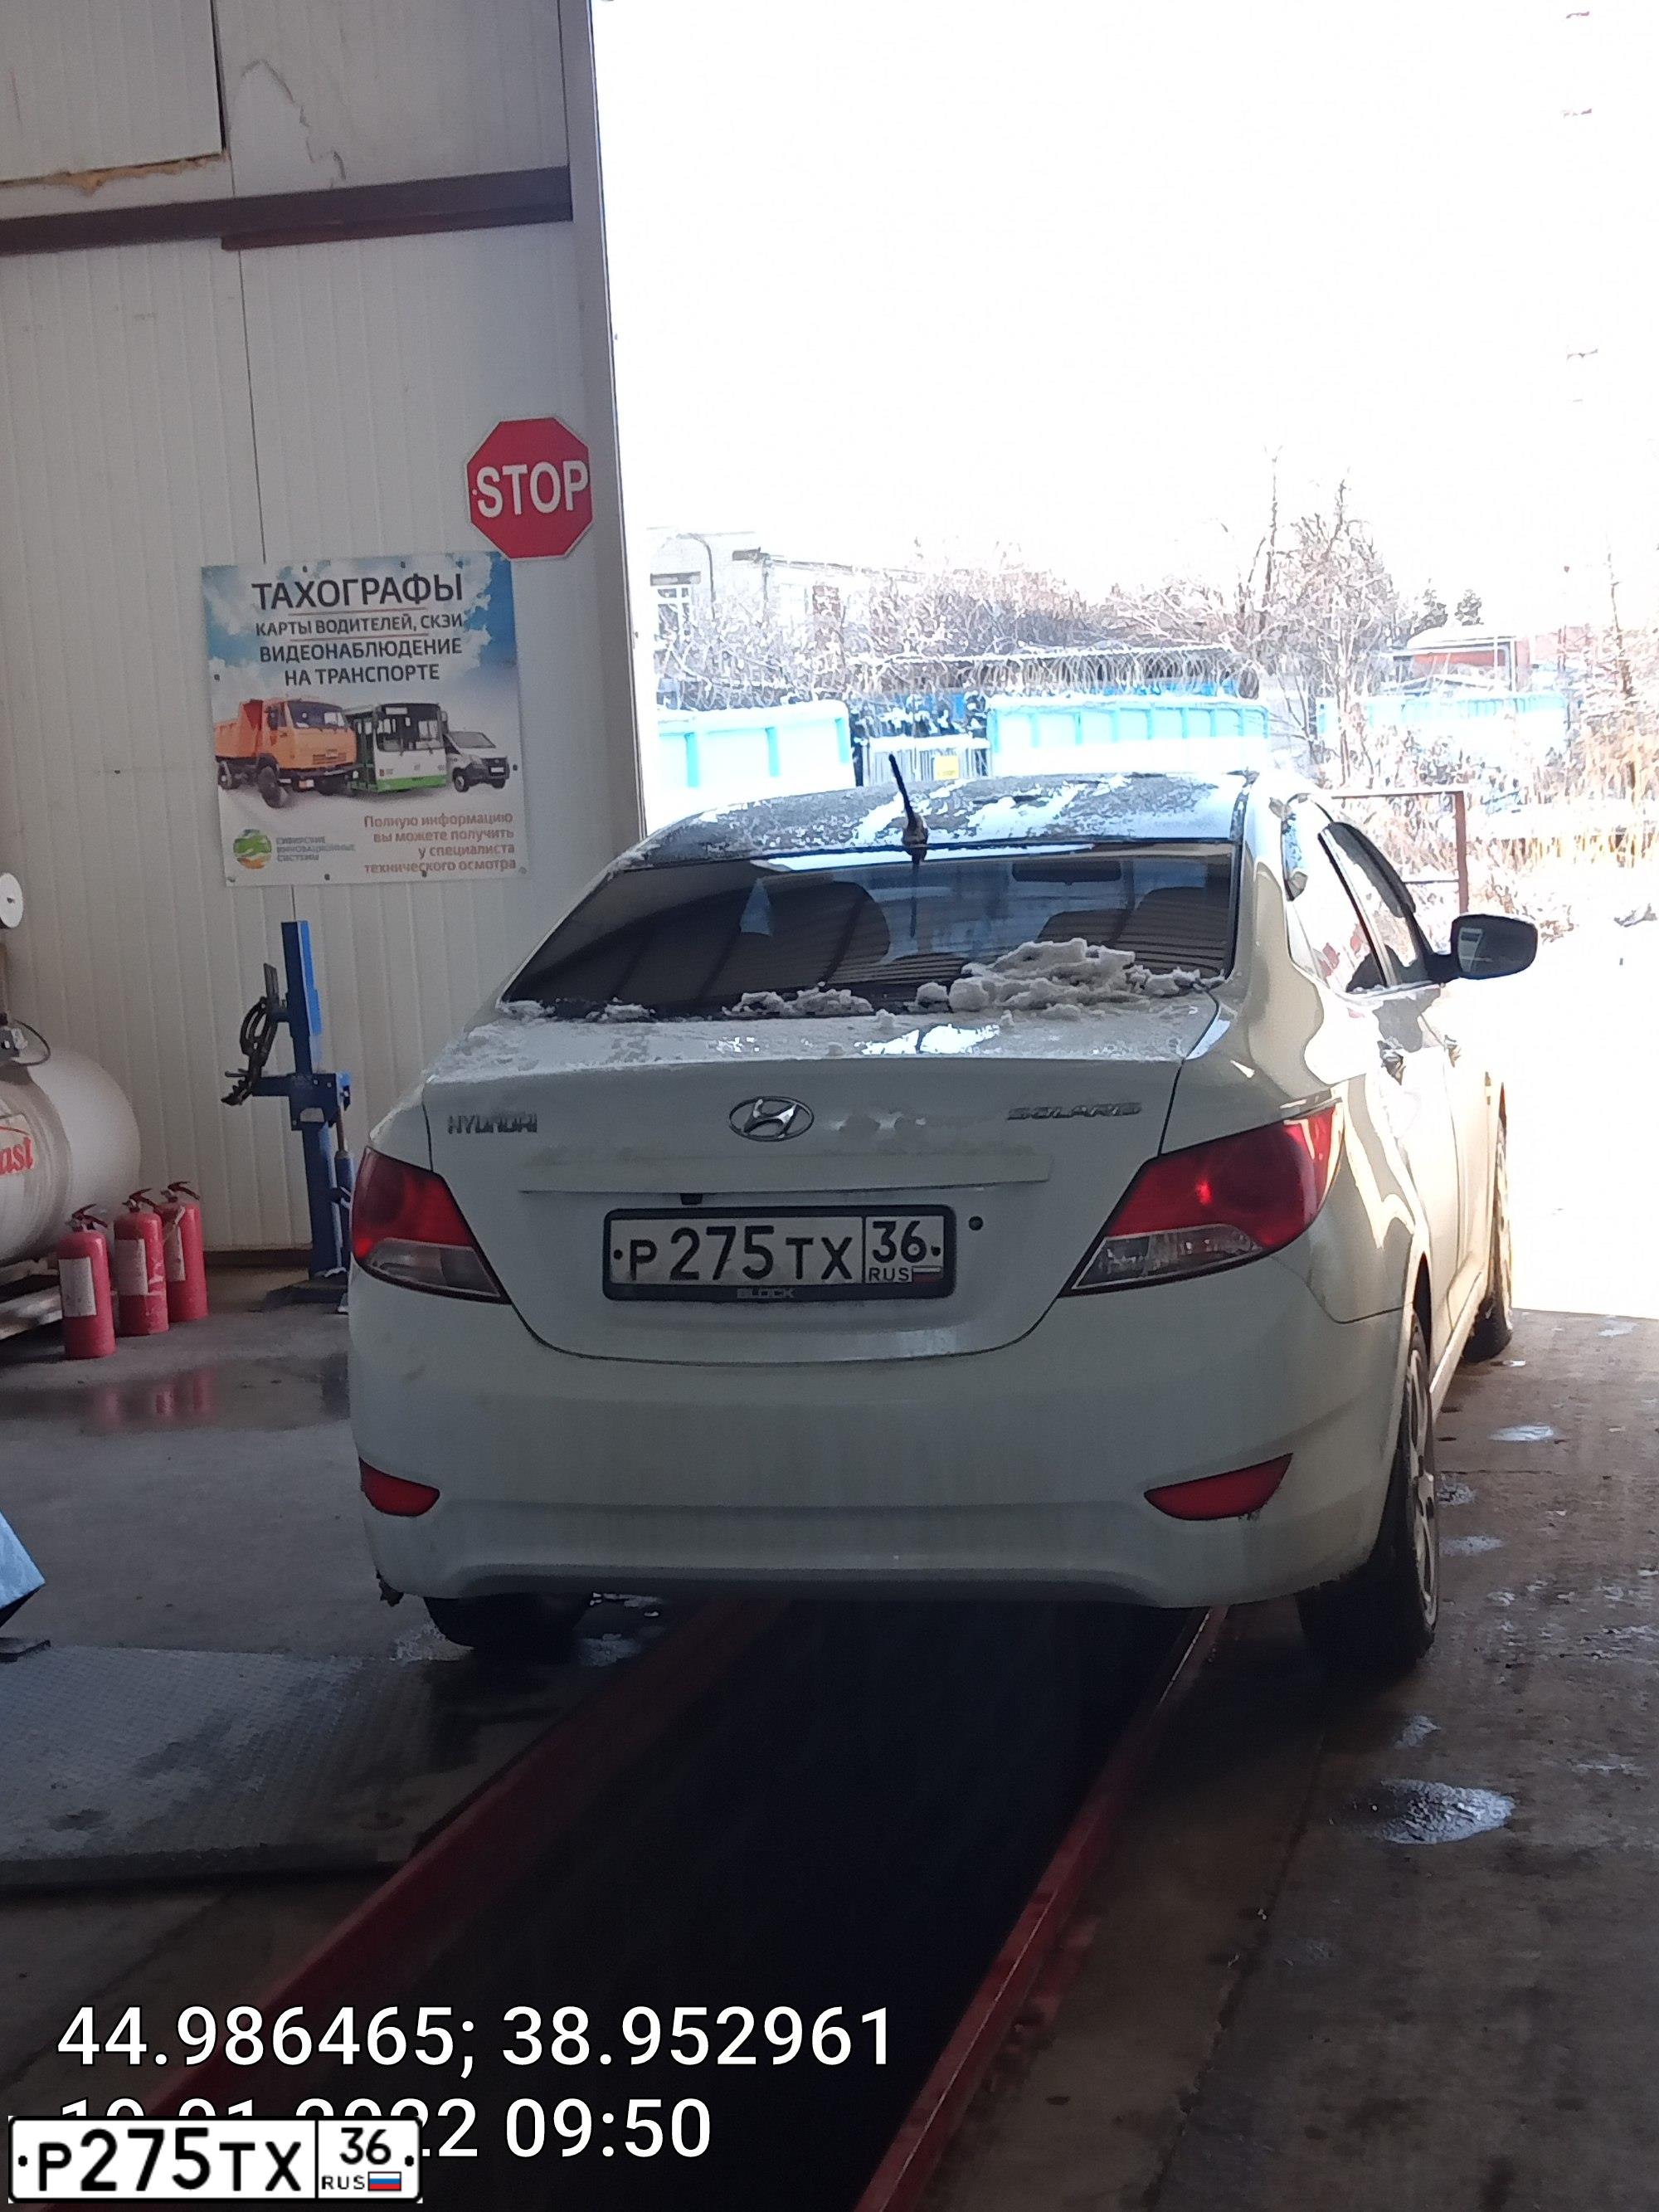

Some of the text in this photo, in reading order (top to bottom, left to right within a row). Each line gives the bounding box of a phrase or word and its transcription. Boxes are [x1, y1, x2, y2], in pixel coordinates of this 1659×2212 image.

[476, 460, 589, 519] STOP
[251, 572, 463, 611] ТАХОГРАФЫ
[255, 613, 463, 636] КАРТЫ ВОДИТЕЛЕЙ, СКЭИ
[259, 637, 463, 664] ВИДЕОНАБЛЮДЕНИЕ
[285, 663, 440, 686] НА ТРАНСПОРТЕ
[363, 812, 513, 830] Полную информацию
[373, 829, 514, 843] вы можете получить
[418, 843, 515, 860] у специалиста
[364, 859, 516, 875] технического осмотра
[871, 1220, 928, 1264] 36
[868, 1266, 909, 1282] RUS
